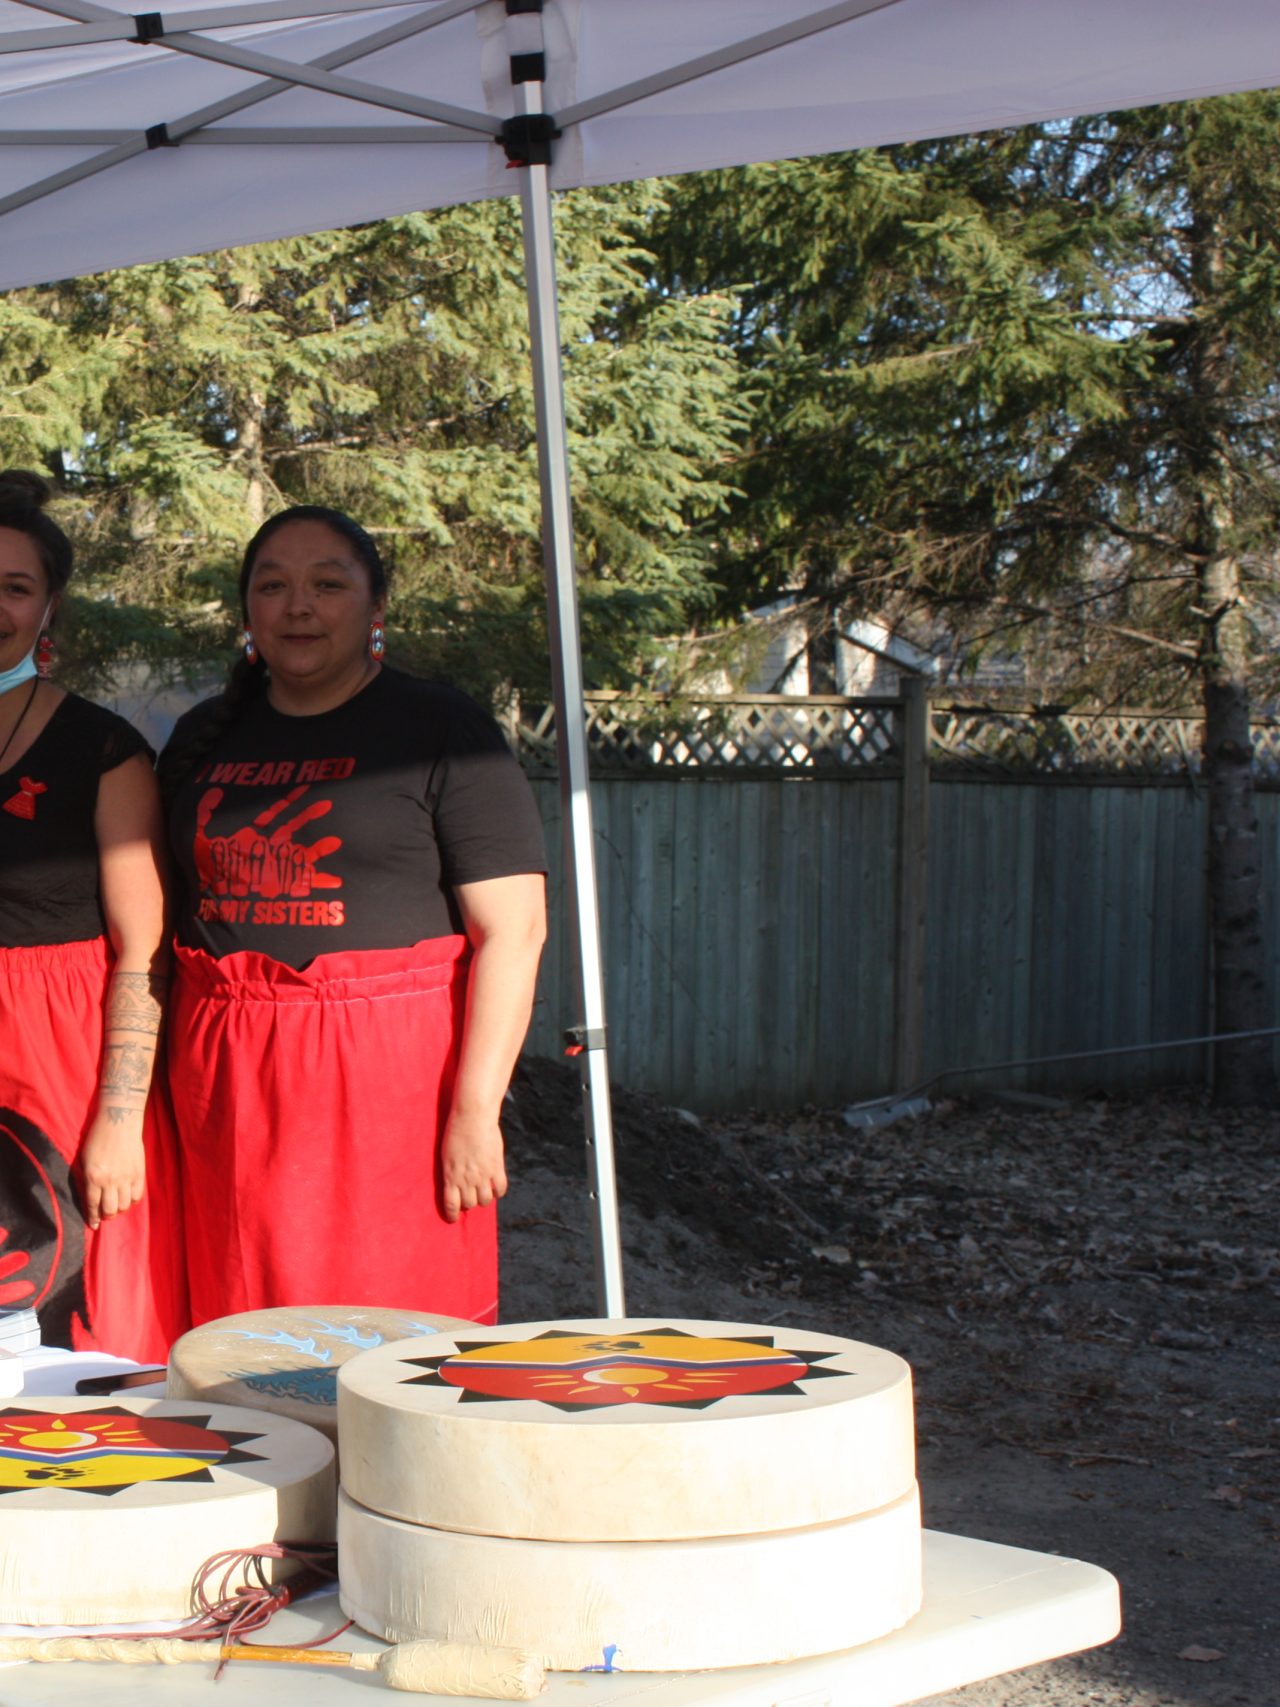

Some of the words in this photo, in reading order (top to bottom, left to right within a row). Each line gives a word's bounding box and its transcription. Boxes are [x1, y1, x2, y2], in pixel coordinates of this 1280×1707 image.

[209, 761, 296, 786] WEAR
[295, 757, 356, 782] RED
[220, 900, 250, 924] MY
[251, 900, 345, 926] SISTERS
